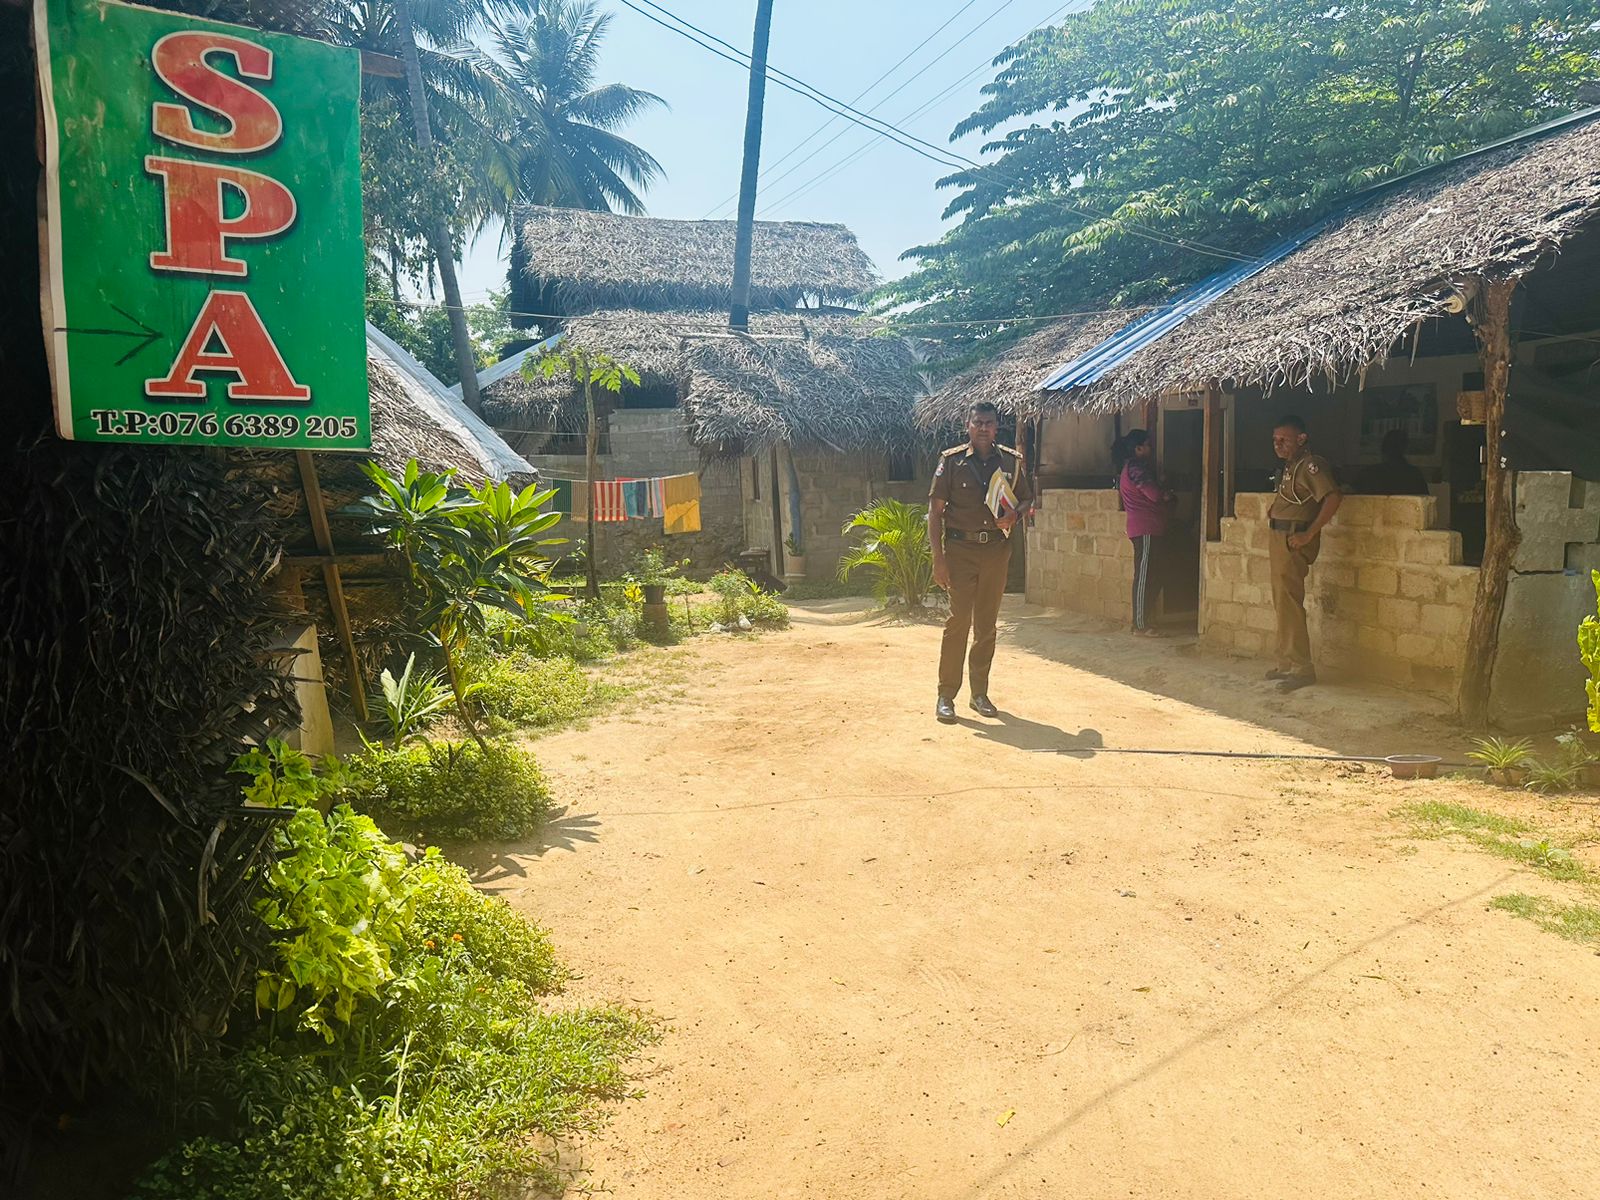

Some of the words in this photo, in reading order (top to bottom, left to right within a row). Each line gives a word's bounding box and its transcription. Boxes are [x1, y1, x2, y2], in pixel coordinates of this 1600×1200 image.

[144, 30, 311, 402] SPA
[91, 409, 219, 437] T.P:076
[224, 413, 300, 438] 6389
[304, 415, 357, 438] 205
